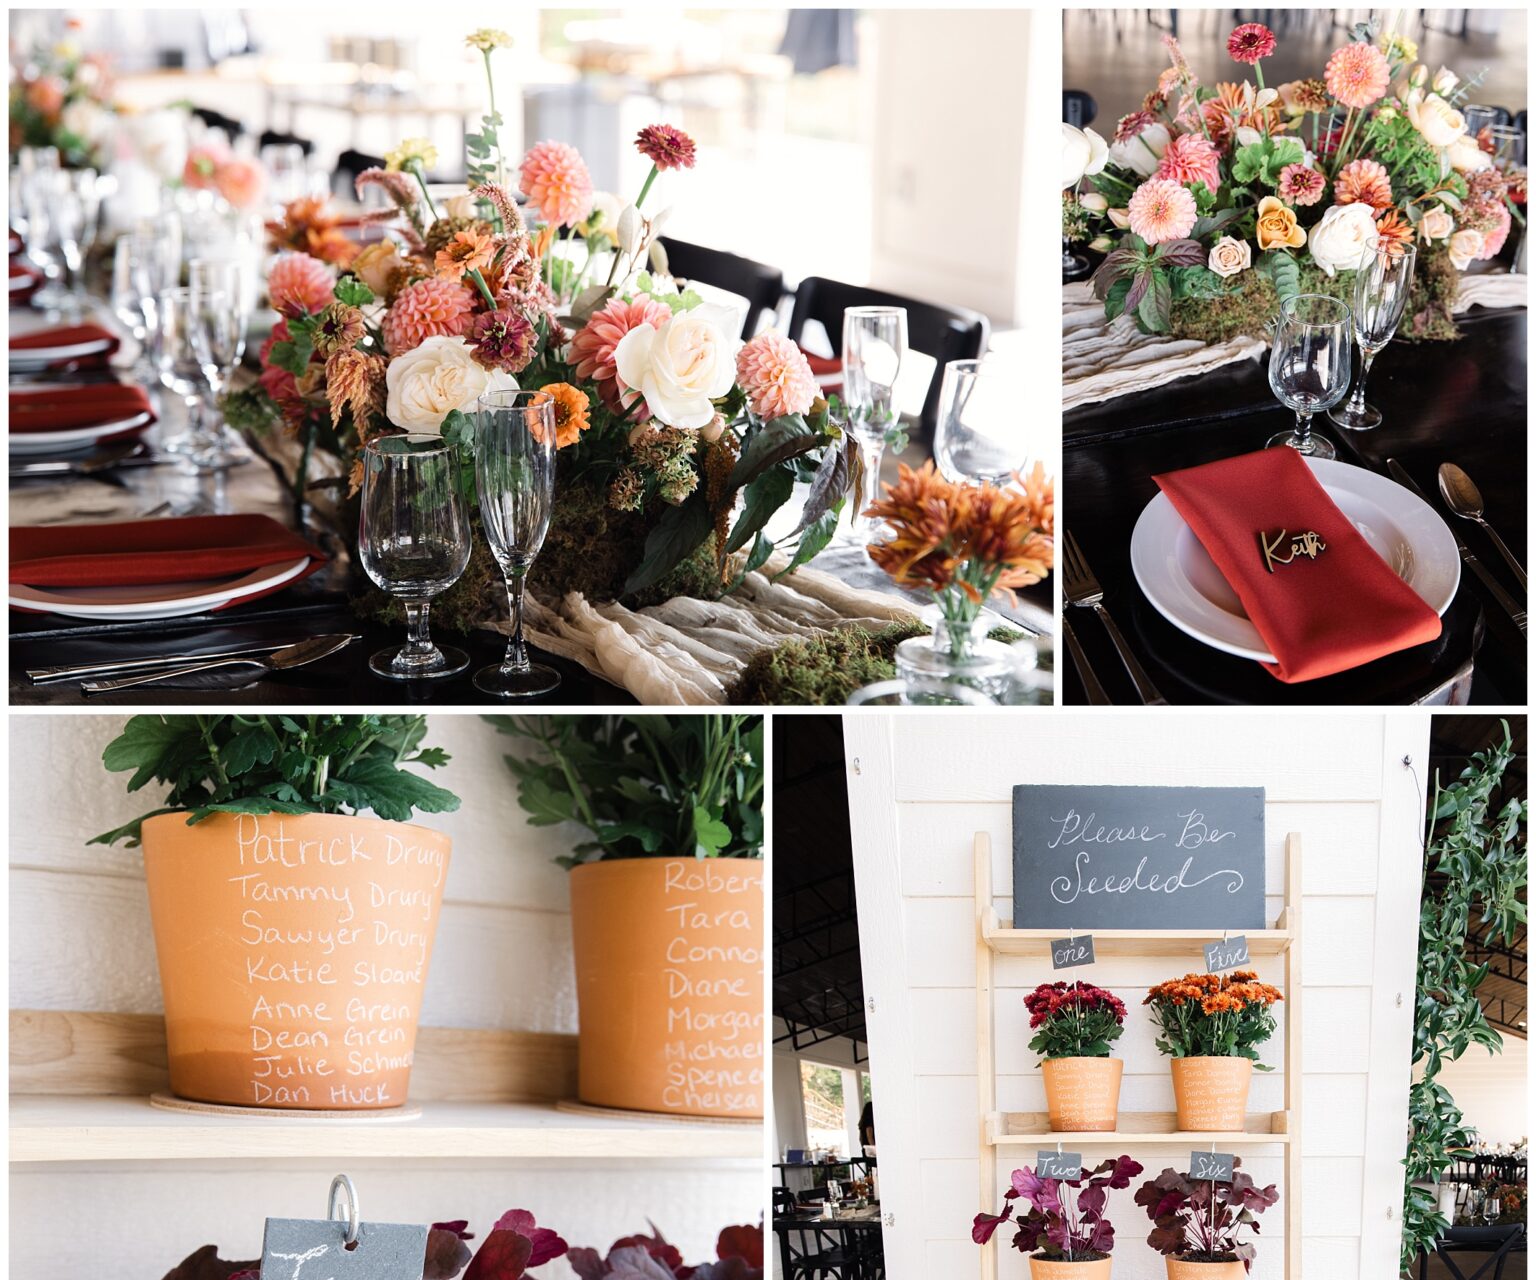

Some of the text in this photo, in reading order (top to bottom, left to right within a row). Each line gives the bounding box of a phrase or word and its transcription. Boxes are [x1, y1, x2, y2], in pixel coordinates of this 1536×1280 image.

[1261, 529, 1326, 573] Keith
[1048, 809, 1236, 850] Please Be
[234, 813, 444, 887] Patrick Drury
[1051, 852, 1243, 904] Seeded
[228, 873, 432, 923] Tammy Drury
[666, 903, 752, 930] Tara
[241, 910, 427, 967] Sawyer Drury
[666, 936, 764, 964] Conno
[247, 955, 337, 985] Katie
[1208, 947, 1248, 972] Five
[664, 969, 750, 999] Diane
[252, 995, 411, 1022] Anne Grein
[250, 1025, 405, 1051] Dean Grein
[664, 1041, 764, 1061] Michael
[253, 1055, 335, 1079] Julie
[250, 1080, 310, 1104] Dan
[662, 1086, 759, 1111] Chelsea
[1038, 1157, 1081, 1177] Two
[1197, 1157, 1228, 1178] Six
